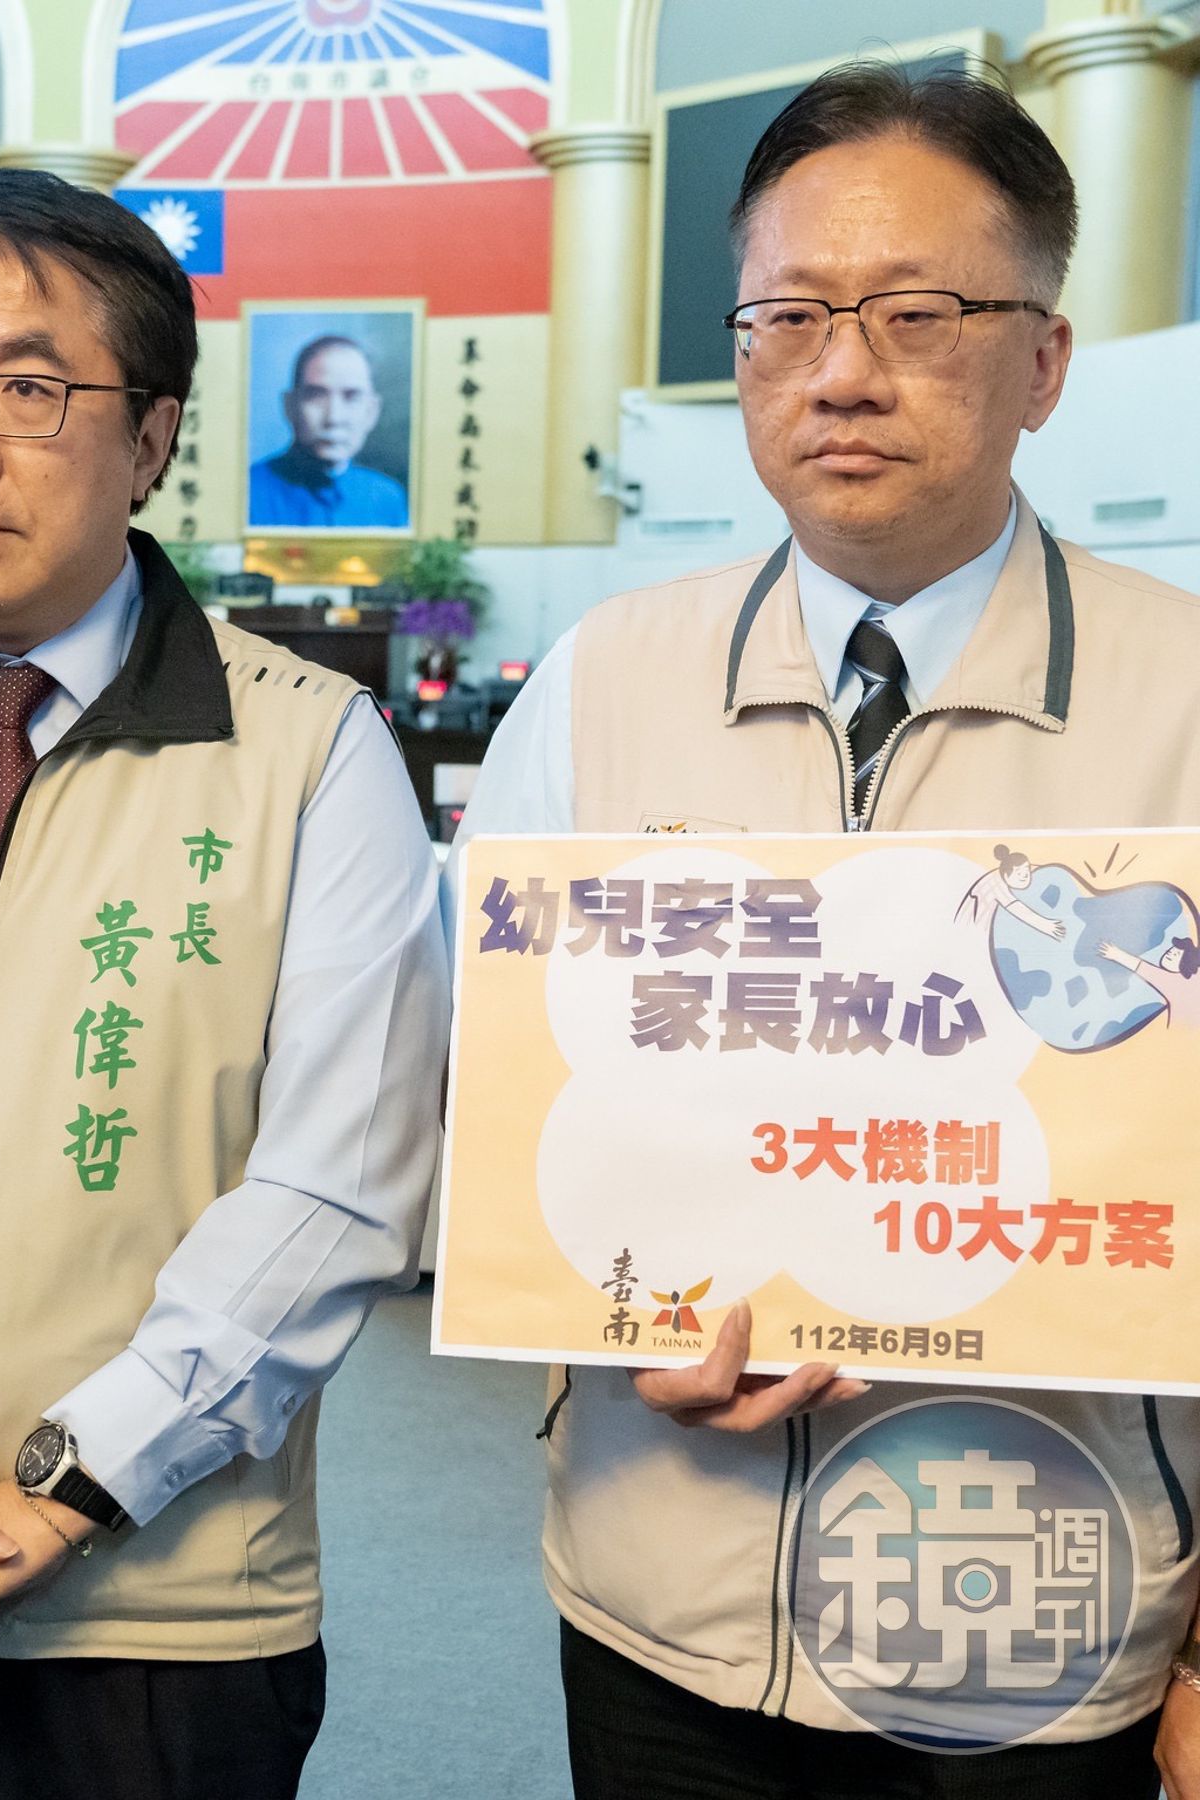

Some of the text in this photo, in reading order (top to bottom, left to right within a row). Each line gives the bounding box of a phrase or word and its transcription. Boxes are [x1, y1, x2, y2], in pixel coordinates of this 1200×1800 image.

[169, 828, 233, 965] 市長
[479, 877, 823, 960] 幼兒安全
[63, 900, 154, 1192] 黃偉哲
[629, 972, 987, 1056] 家長放心
[750, 1117, 1000, 1186] 3大機制
[873, 1197, 1175, 1269] 10大方案
[601, 1248, 640, 1346] 臺南
[651, 1336, 702, 1349] TAINAN
[790, 1324, 984, 1361] 112年6月9日
